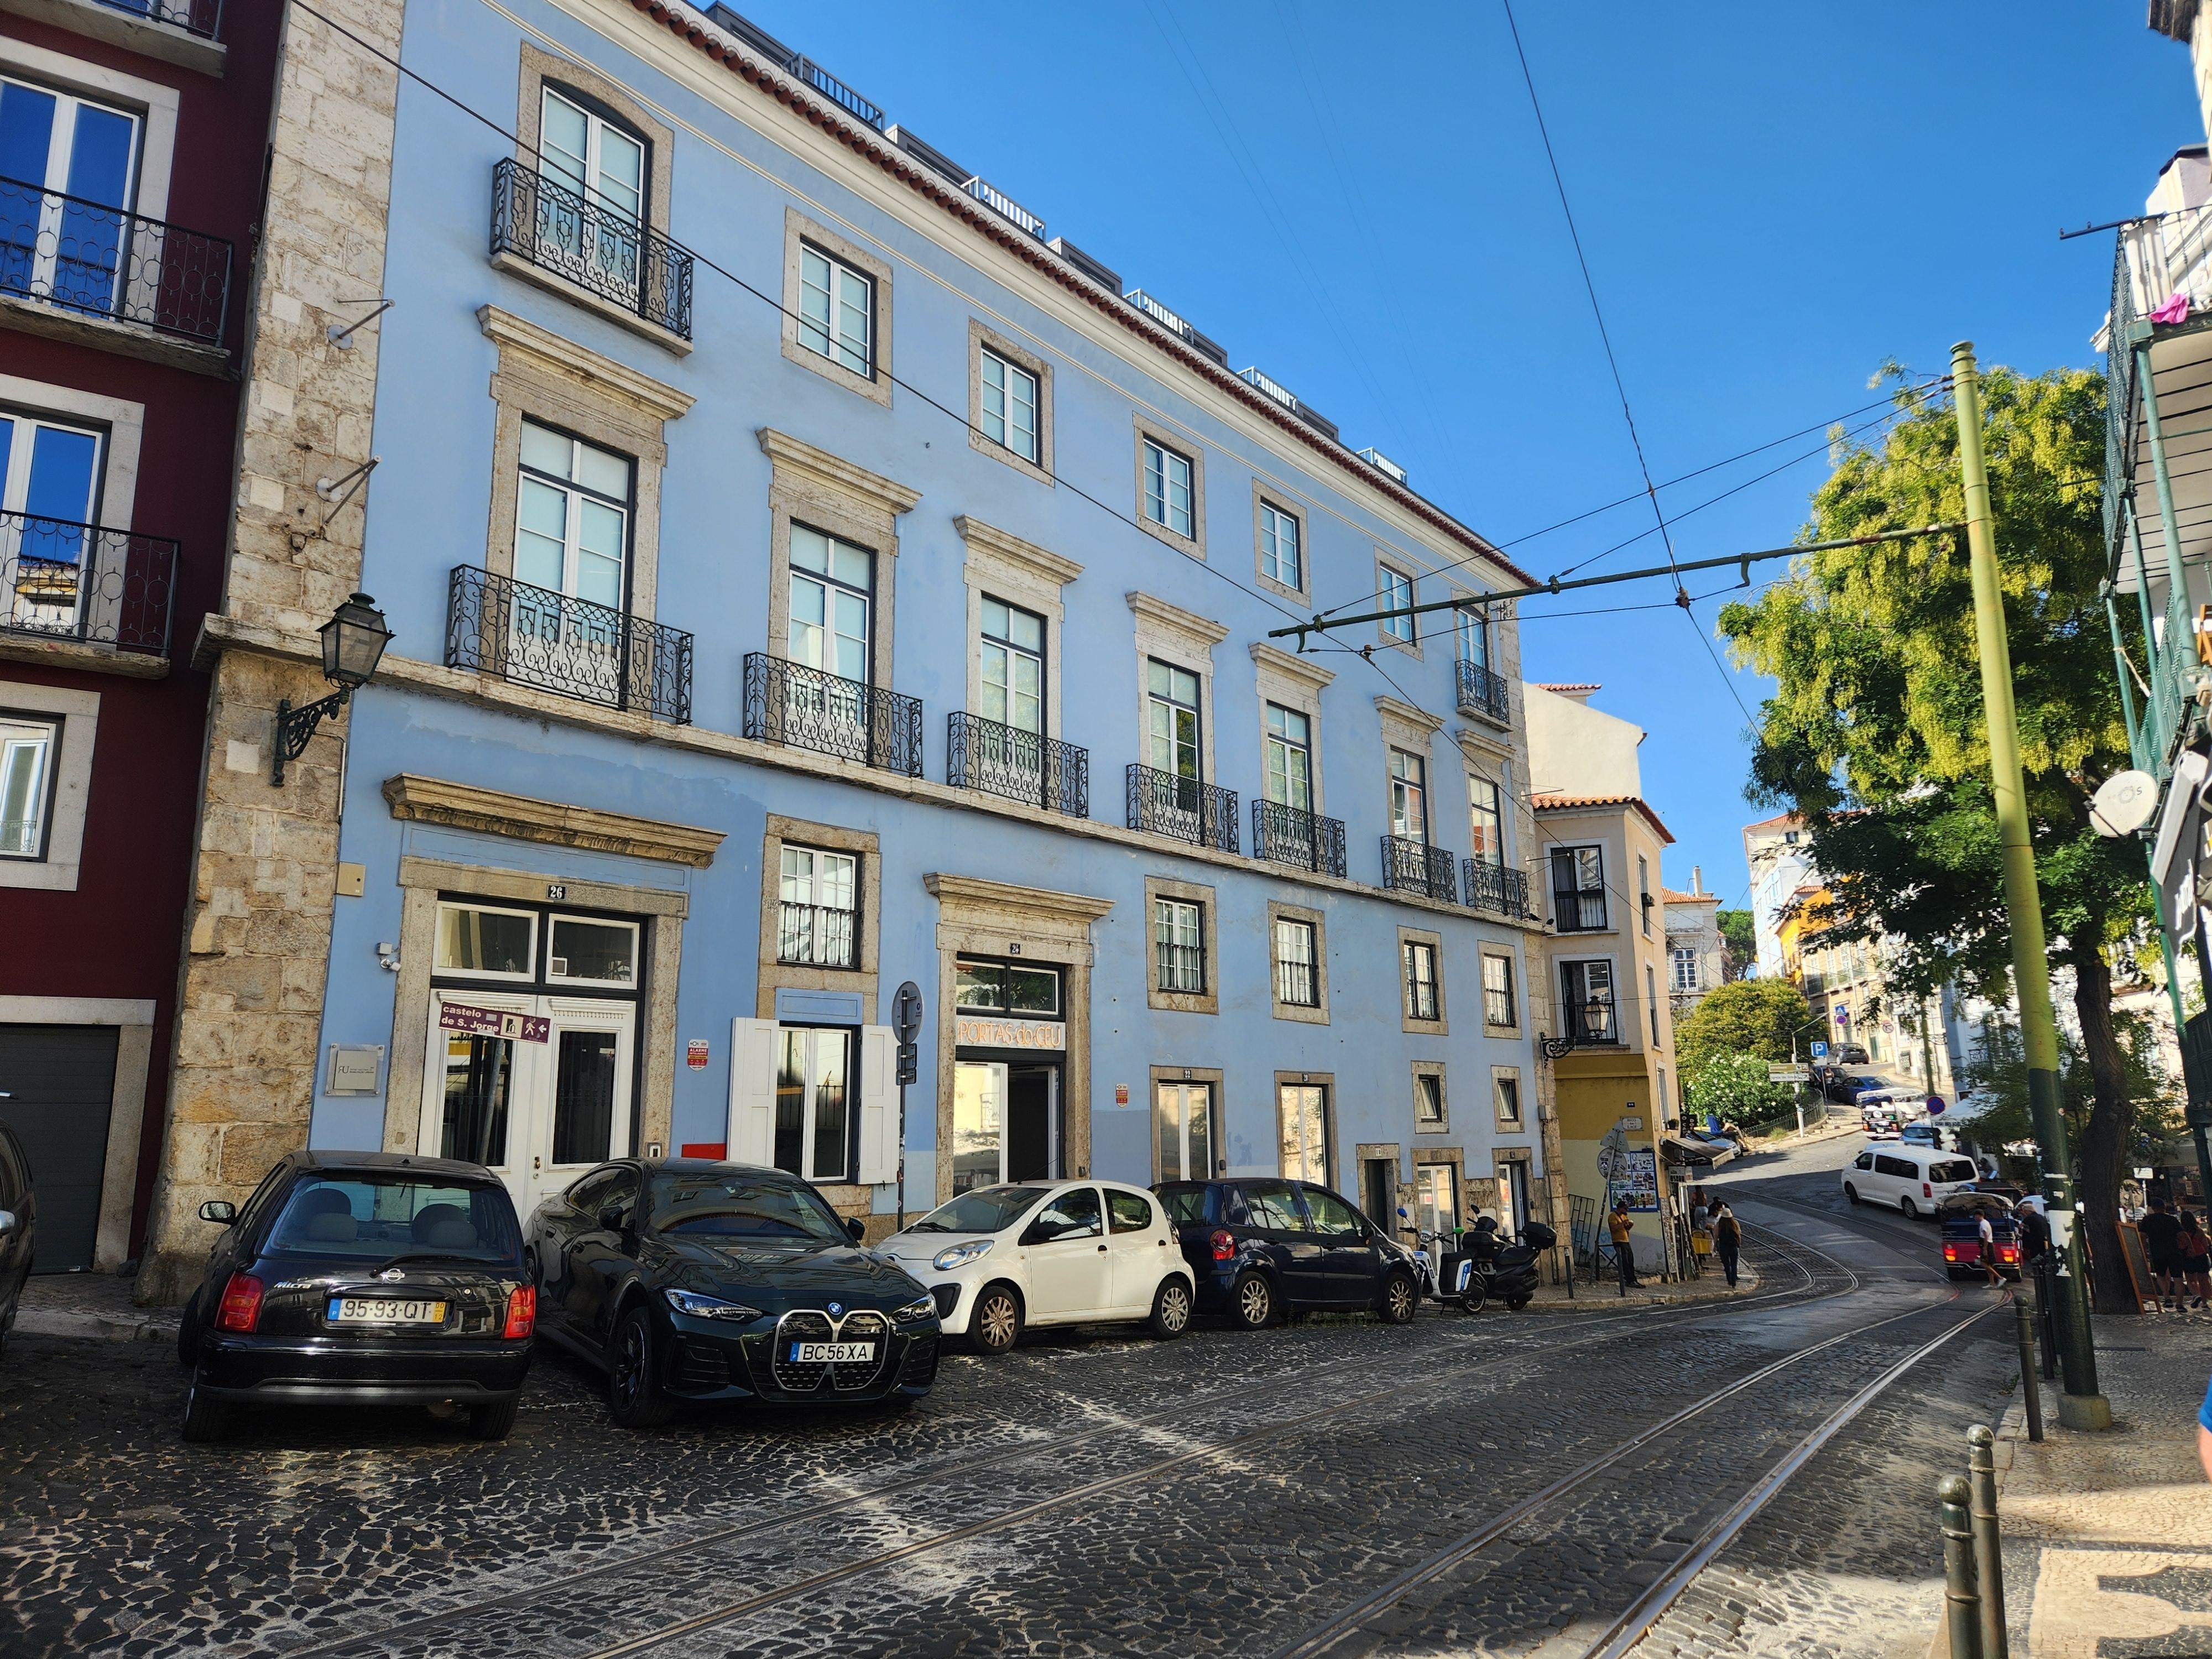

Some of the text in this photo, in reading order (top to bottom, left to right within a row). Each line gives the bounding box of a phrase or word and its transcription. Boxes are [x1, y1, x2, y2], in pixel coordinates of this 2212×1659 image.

[550, 886, 562, 899] 26
[1012, 944, 1019, 953] 24
[443, 1006, 482, 1018] castelo
[441, 1016, 499, 1032] de S. Jorge
[958, 1021, 1061, 1046] PORTAS do CÉU
[1815, 1044, 1823, 1055] P
[1185, 1070, 1191, 1078] 22
